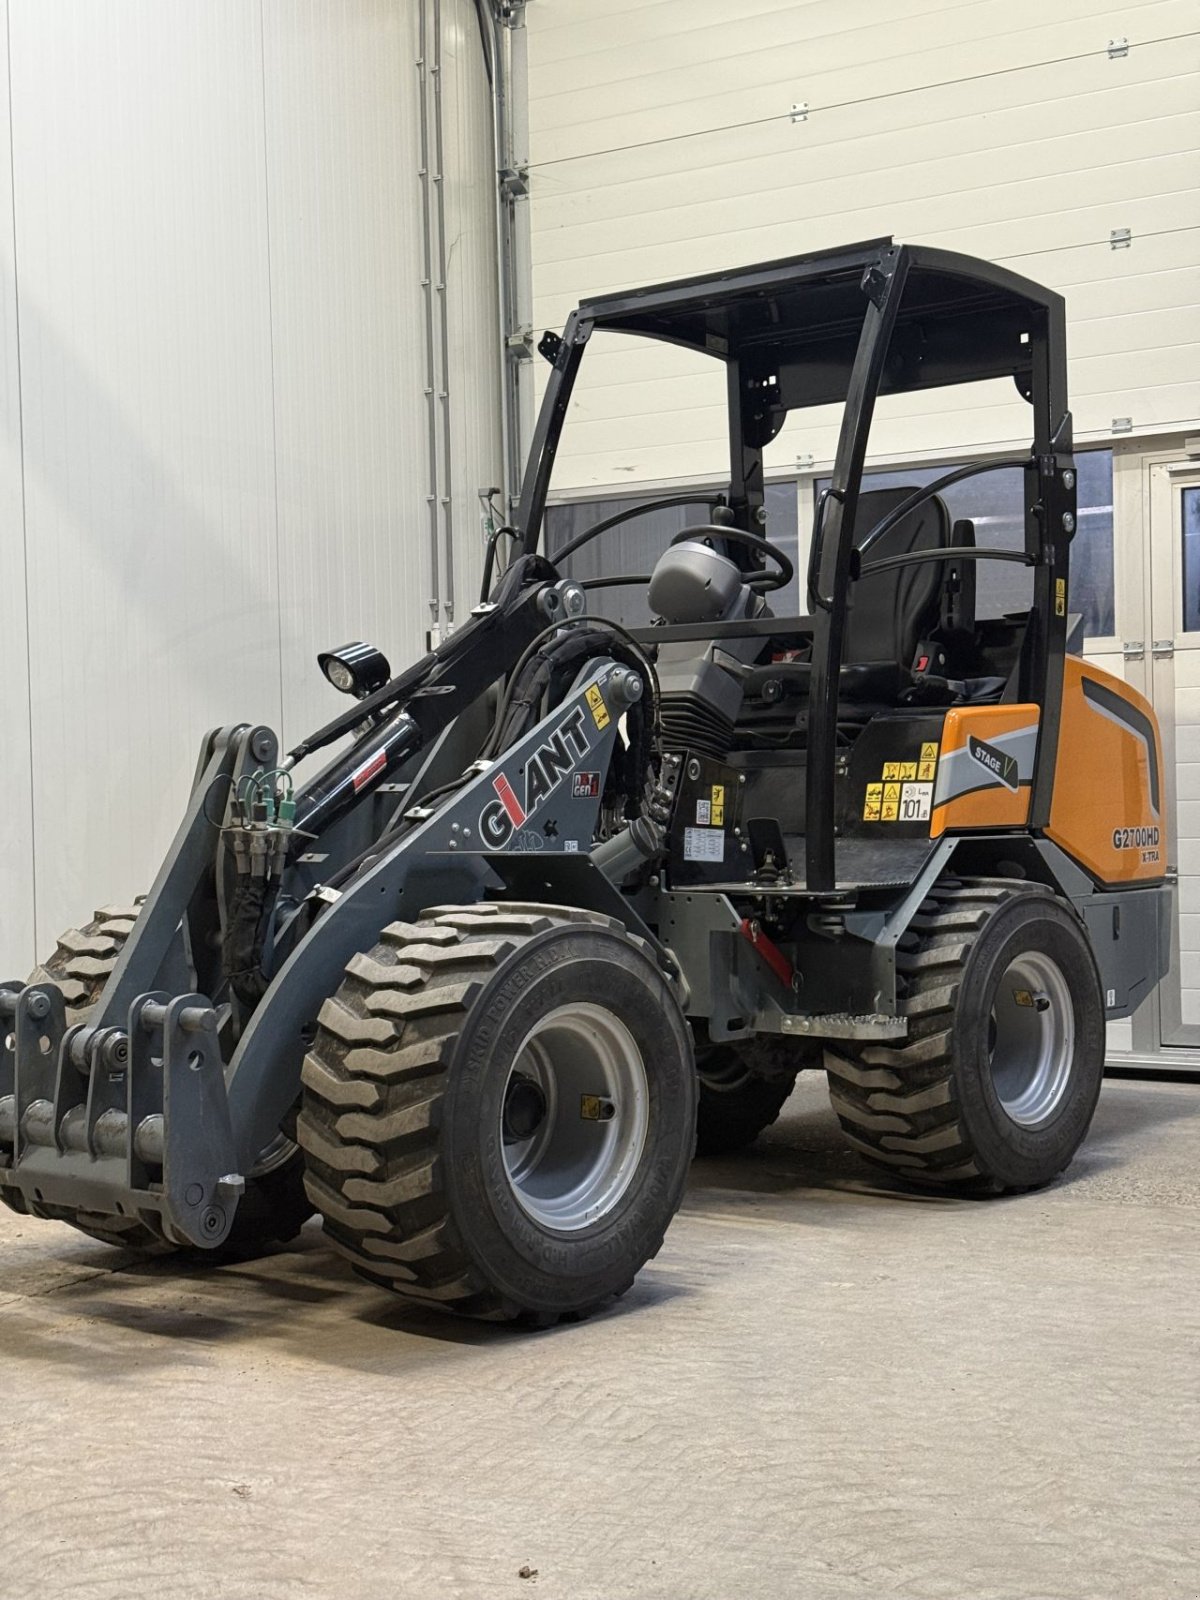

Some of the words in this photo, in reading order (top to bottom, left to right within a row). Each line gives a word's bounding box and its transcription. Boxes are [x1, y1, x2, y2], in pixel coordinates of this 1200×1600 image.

[974, 746, 1002, 773] STAGE
[1003, 755, 1017, 779] V
[478, 705, 591, 851] GIANT
[902, 799, 921, 818] 101
[1112, 826, 1160, 850] G2700HD
[1141, 850, 1160, 863] X-TRA
[485, 965, 535, 1023] POWER
